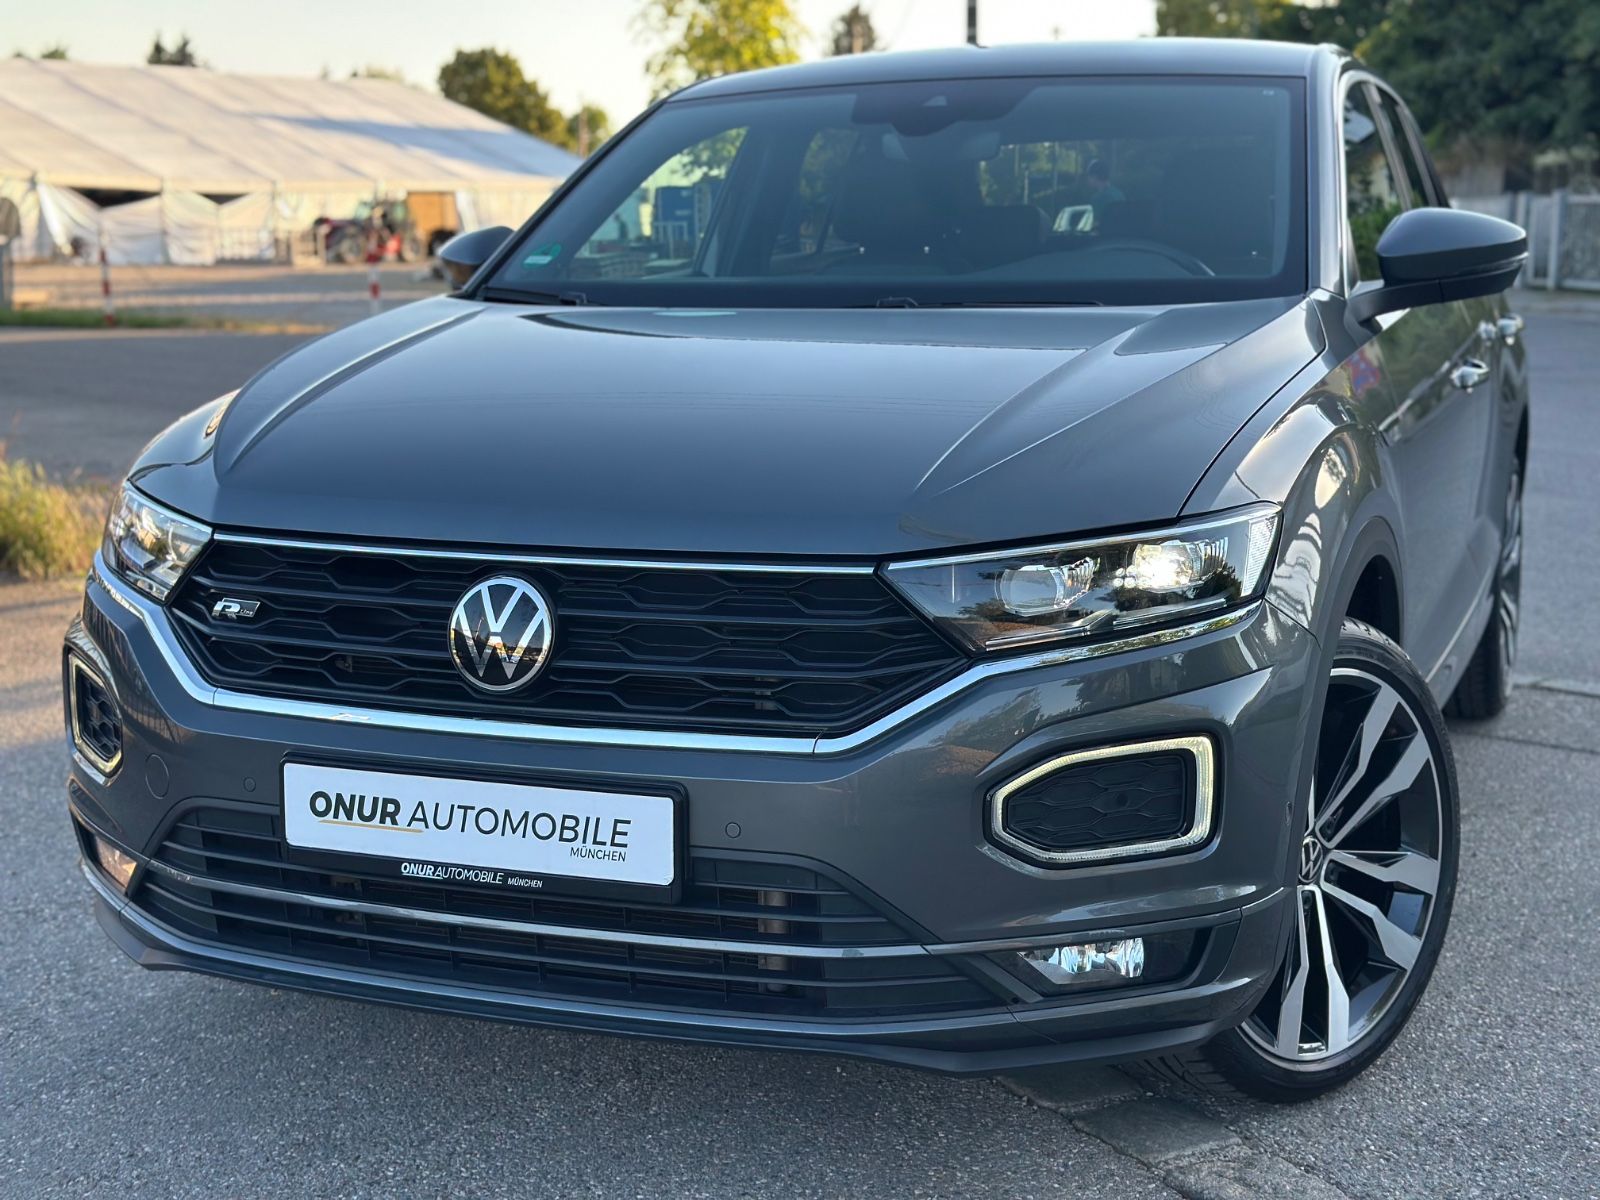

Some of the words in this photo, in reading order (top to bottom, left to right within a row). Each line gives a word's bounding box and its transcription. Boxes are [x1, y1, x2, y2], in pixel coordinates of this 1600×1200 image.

[211, 600, 241, 620] R
[453, 579, 550, 686] VW
[309, 792, 400, 825] ONUR
[407, 801, 632, 848] AUTOMOBILE
[570, 846, 626, 862] MÜNCHEN
[401, 862, 434, 876] ONUR
[434, 867, 504, 884] AUTOMOBILE
[507, 876, 543, 888] MÜNCHEN
